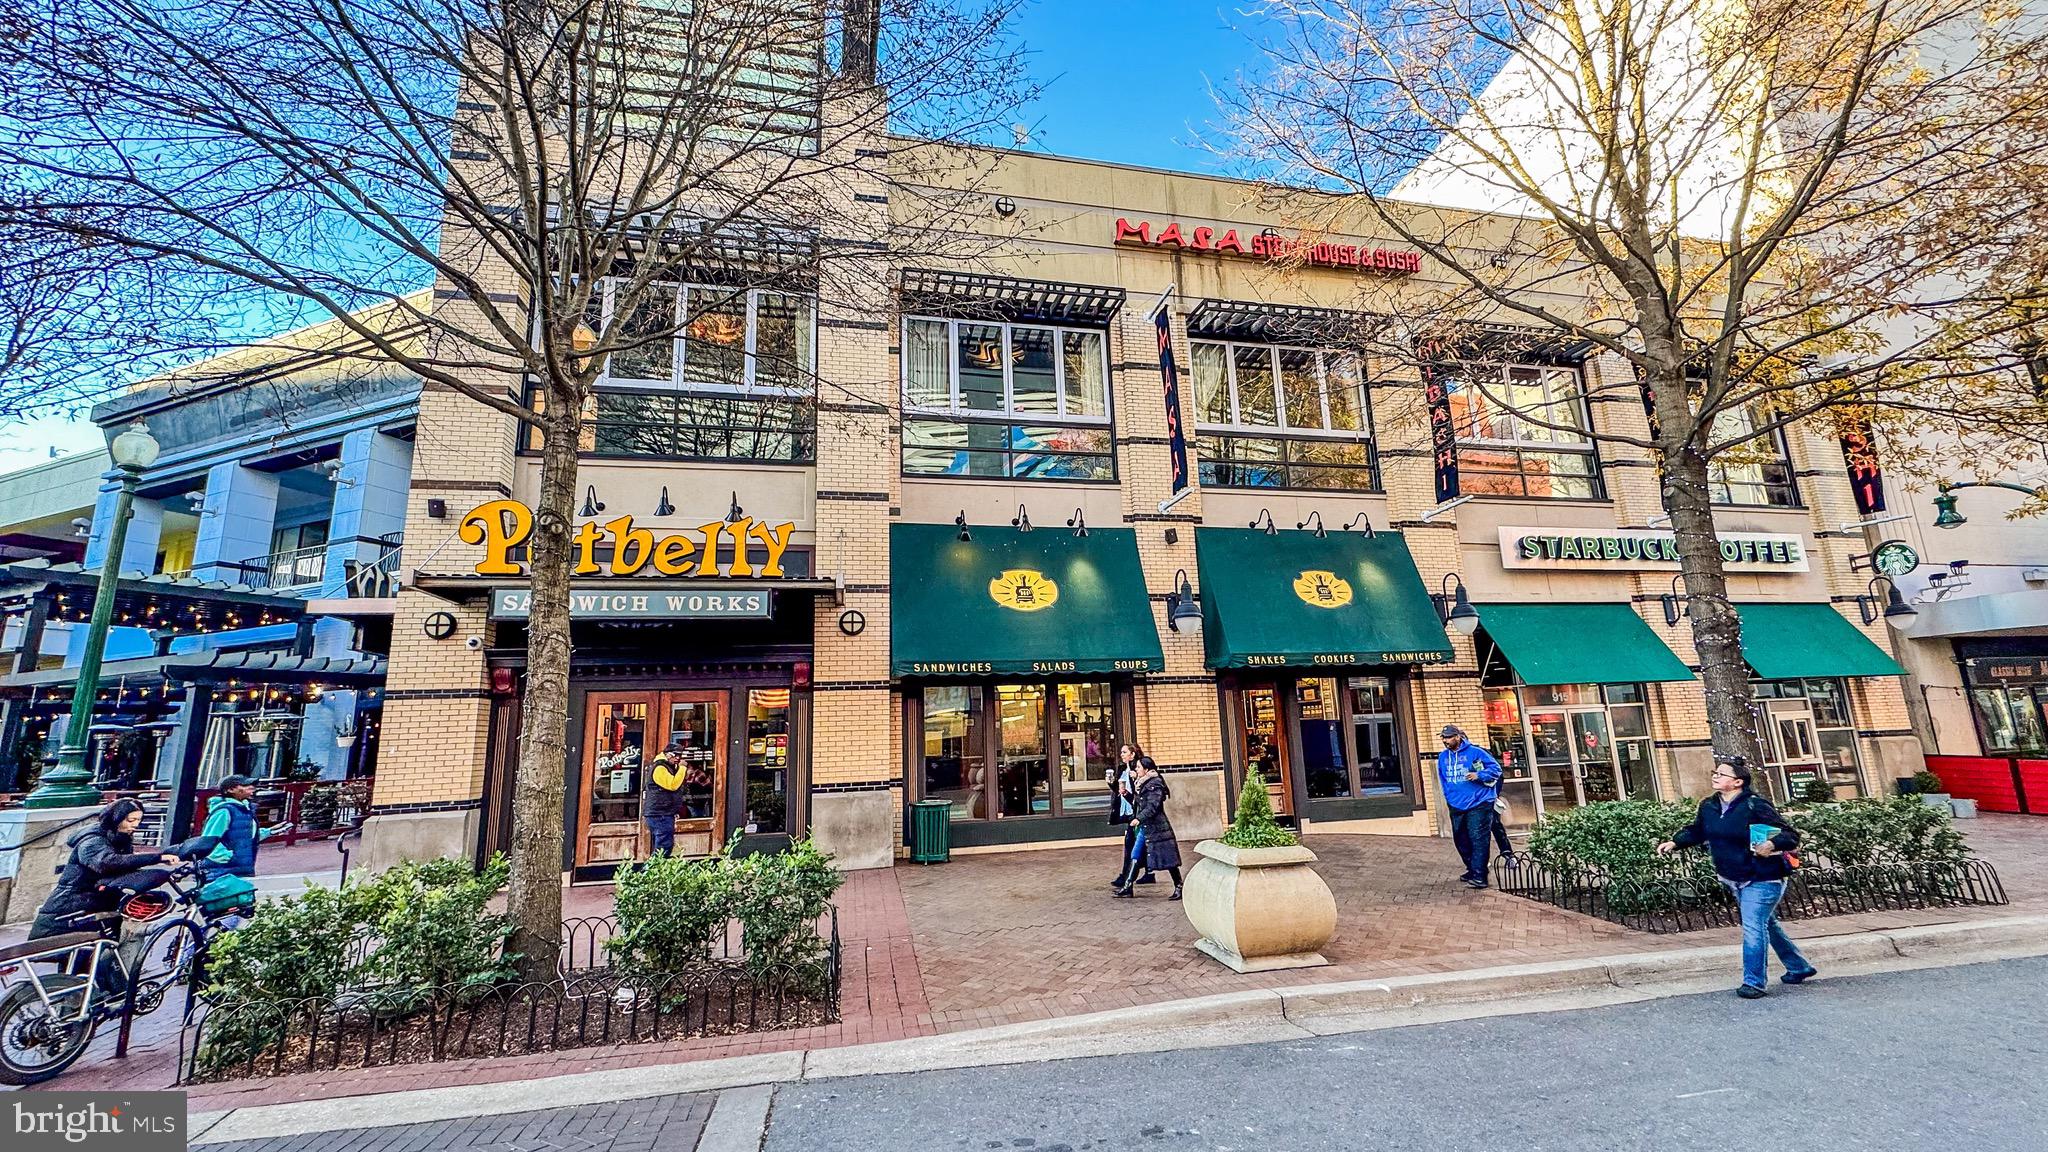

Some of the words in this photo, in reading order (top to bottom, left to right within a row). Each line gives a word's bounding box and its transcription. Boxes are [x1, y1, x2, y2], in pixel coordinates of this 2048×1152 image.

[1114, 217, 1245, 255] MASA
[1361, 247, 1374, 267] &
[1375, 248, 1422, 273] SUSHI
[459, 500, 796, 577] Ptbelly
[1520, 535, 1681, 560] STARBUCK
[1719, 539, 1801, 562] OFFEE
[666, 595, 761, 612] WORKS
[913, 662, 992, 673] SANDWICHES
[1033, 661, 1075, 672] SALADS
[1114, 660, 1148, 670] SOUPS
[1247, 655, 1286, 665] SHAKES
[1313, 654, 1355, 664] COOKIES
[1382, 652, 1442, 662] SANDWICHES
[1552, 692, 1569, 702] 915
